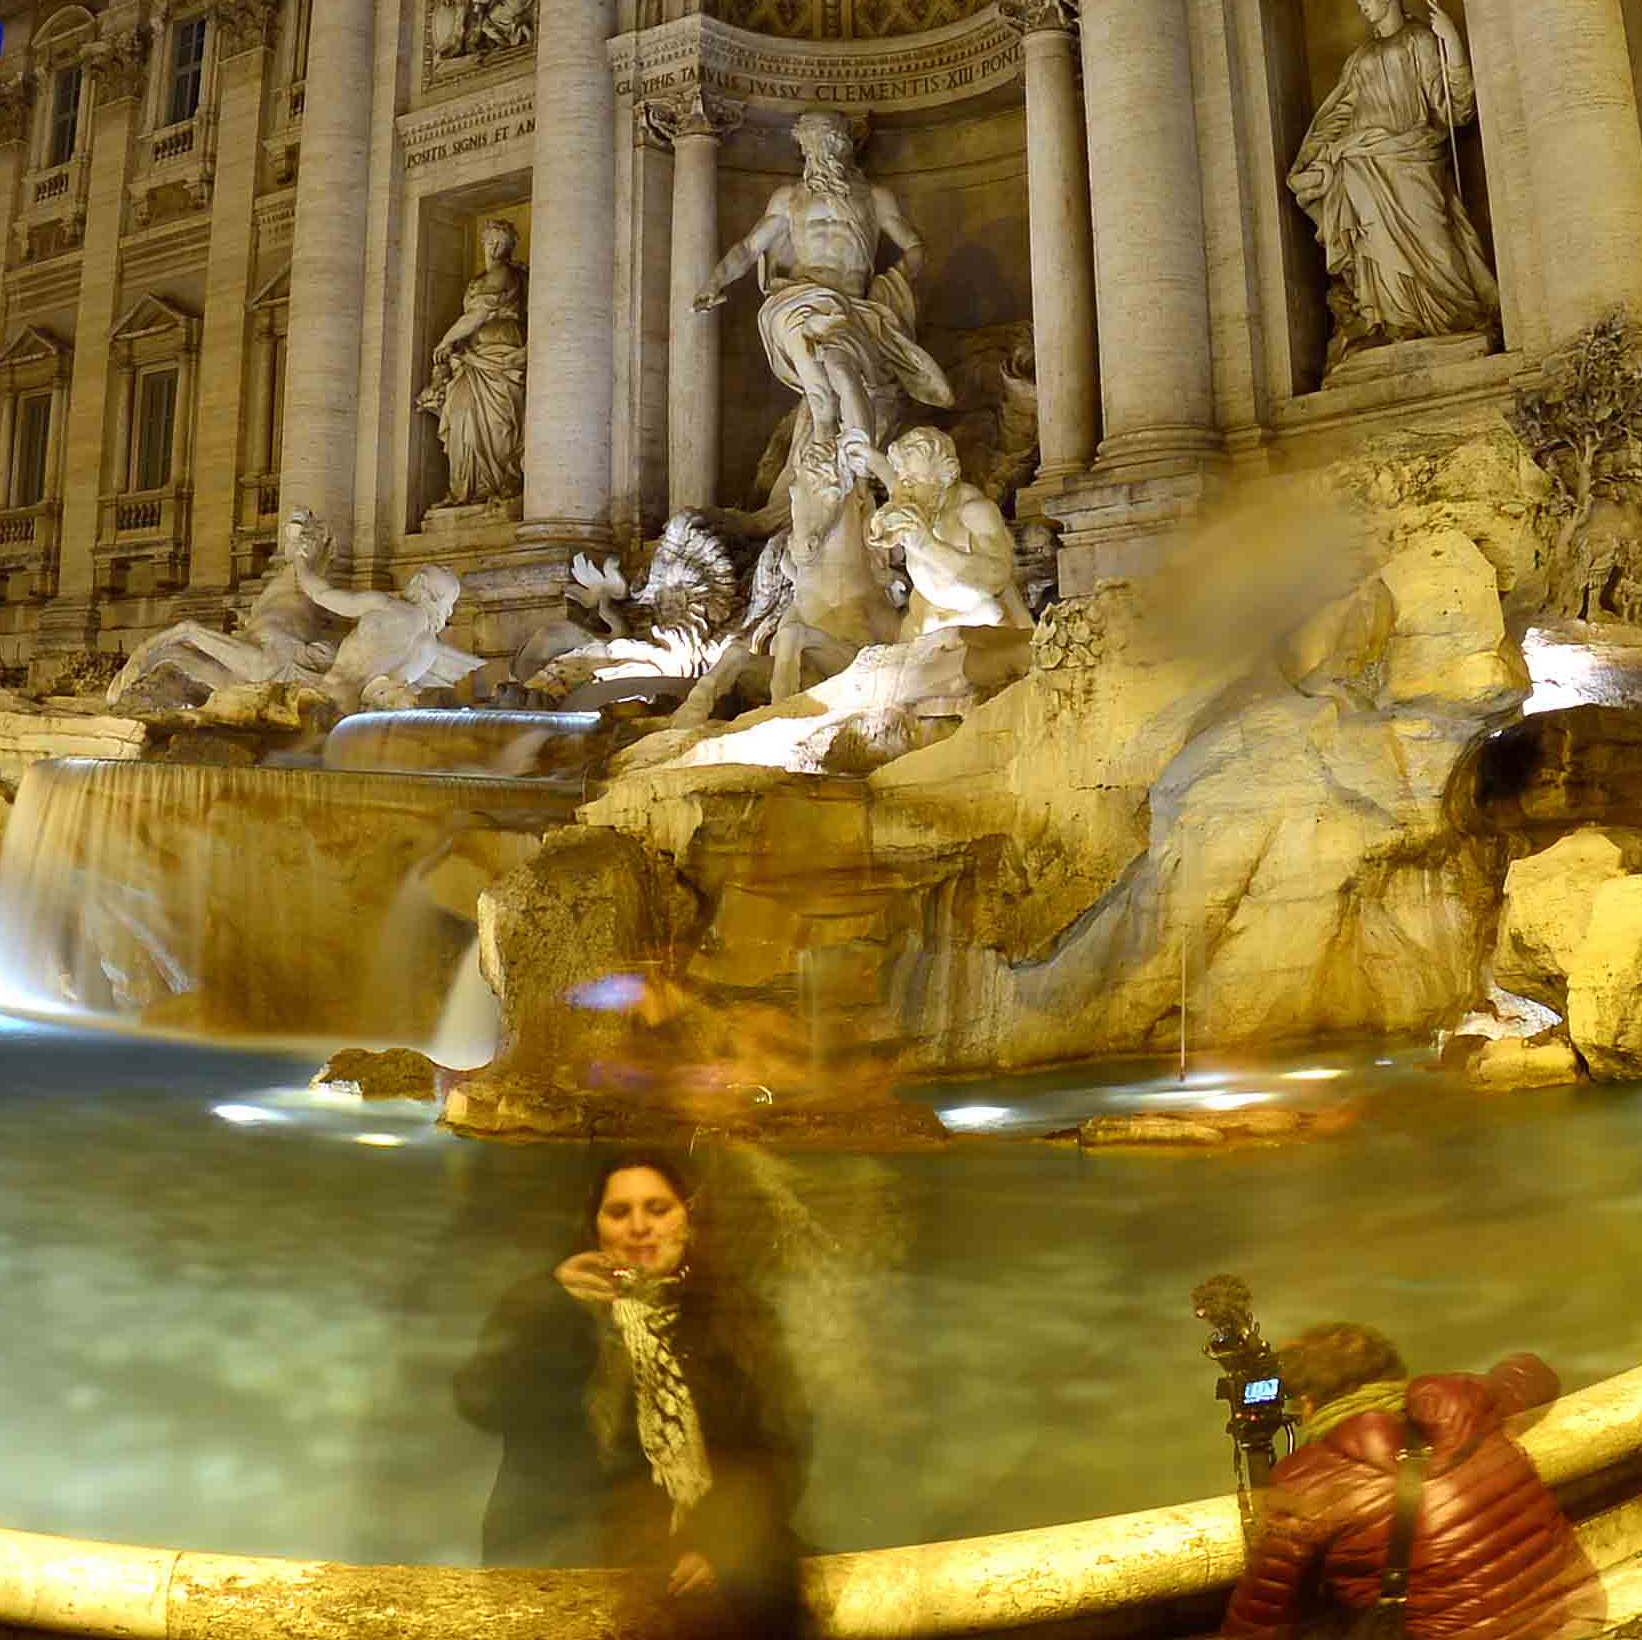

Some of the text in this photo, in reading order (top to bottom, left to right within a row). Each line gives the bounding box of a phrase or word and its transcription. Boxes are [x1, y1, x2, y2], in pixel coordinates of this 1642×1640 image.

[748, 78, 802, 100] IVSSV
[406, 143, 447, 169] POSITIS
[452, 133, 488, 154] SIGNIS
[494, 125, 510, 143] ET
